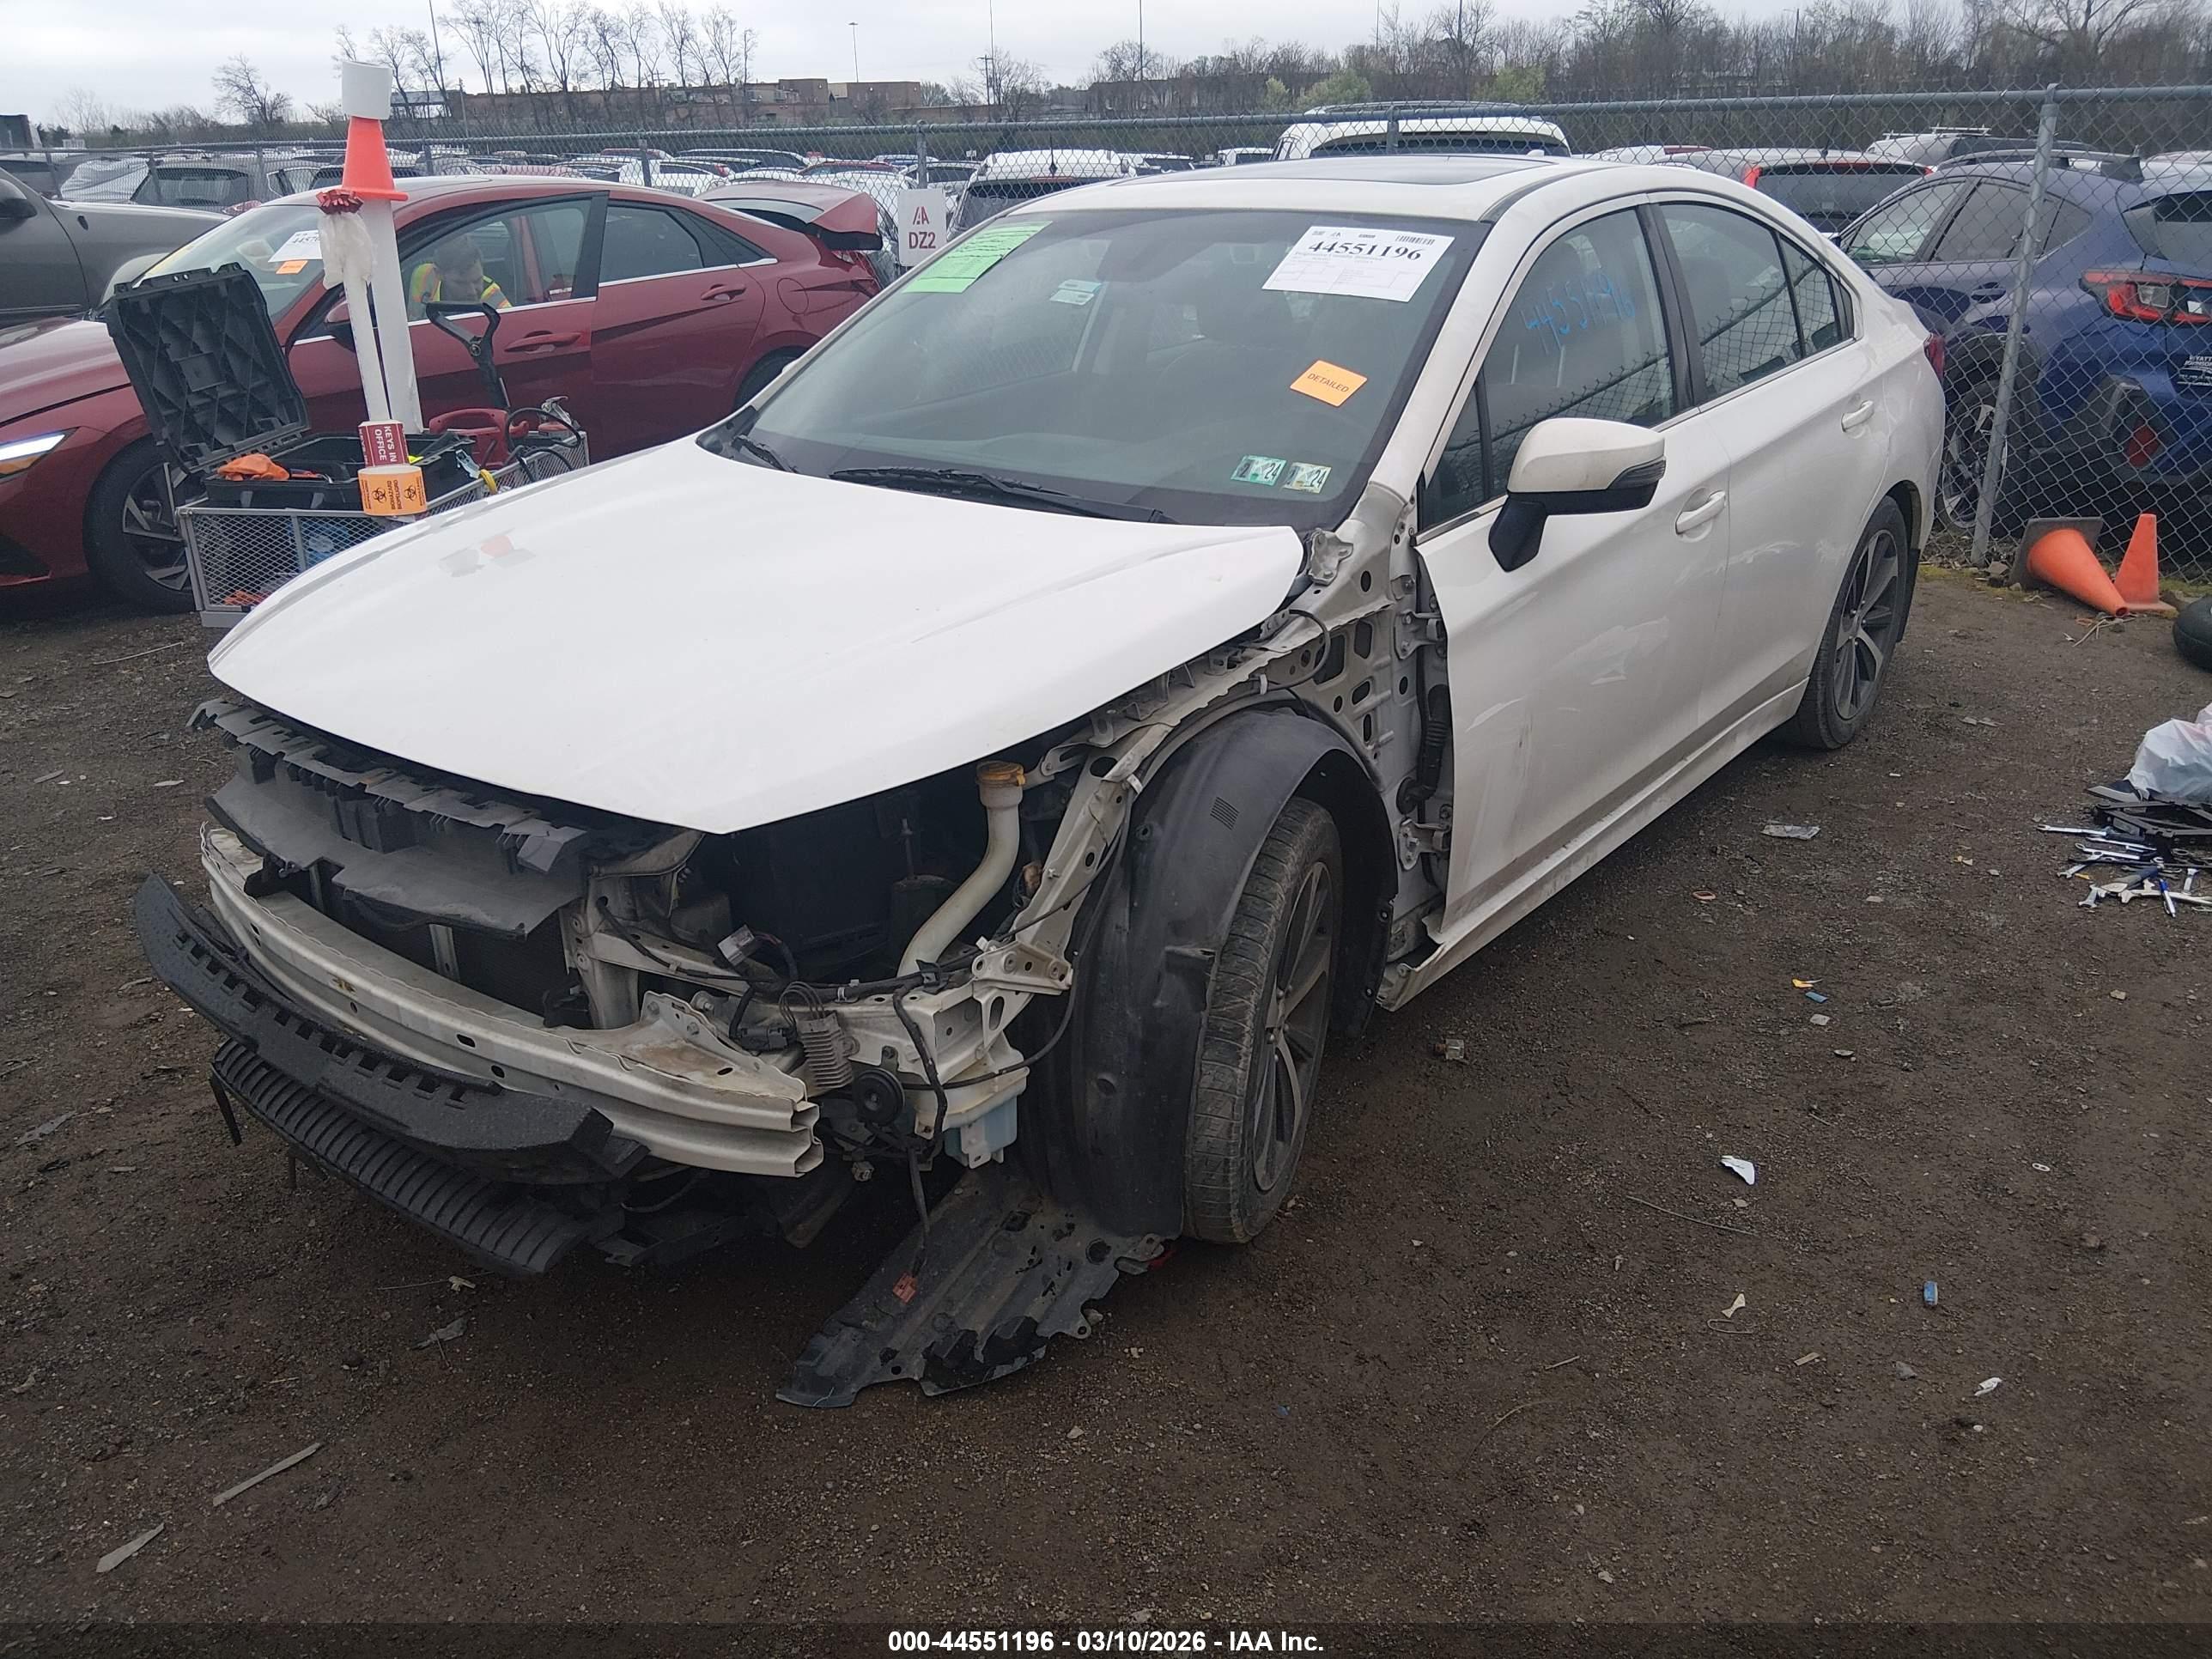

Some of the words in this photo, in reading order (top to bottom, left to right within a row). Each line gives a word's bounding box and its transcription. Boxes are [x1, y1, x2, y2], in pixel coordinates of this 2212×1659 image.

[908, 231, 936, 249] DZ2
[1309, 240, 1424, 261] 44551196
[1307, 373, 1350, 392] DETAILED
[374, 428, 387, 461] OFFICE
[384, 426, 395, 450] KEYS
[389, 452, 398, 463] IN
[1264, 463, 1281, 481] 24
[1310, 469, 1328, 489] 24
